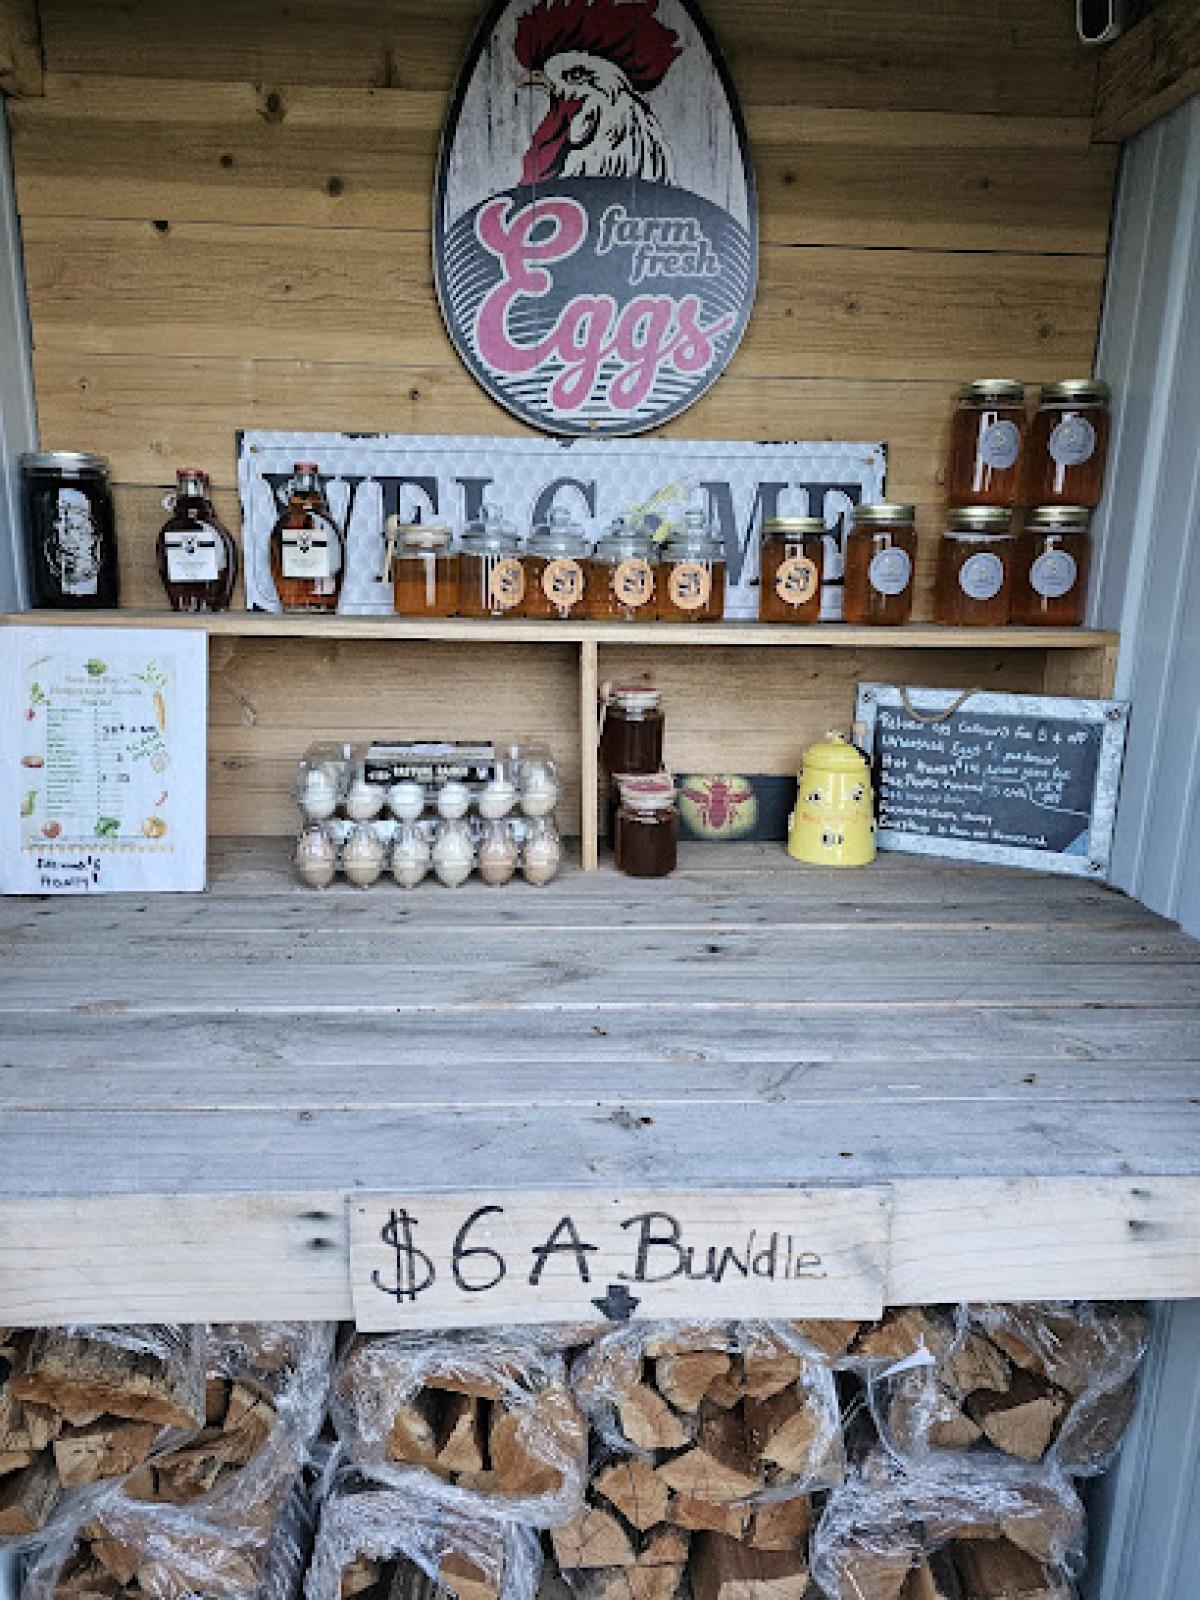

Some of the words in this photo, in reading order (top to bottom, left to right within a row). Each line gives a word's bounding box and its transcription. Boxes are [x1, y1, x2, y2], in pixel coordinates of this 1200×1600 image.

[597, 205, 704, 254] farm
[630, 242, 719, 284] fresh
[475, 197, 737, 410] Eggs
[528, 1215, 599, 1286] A
